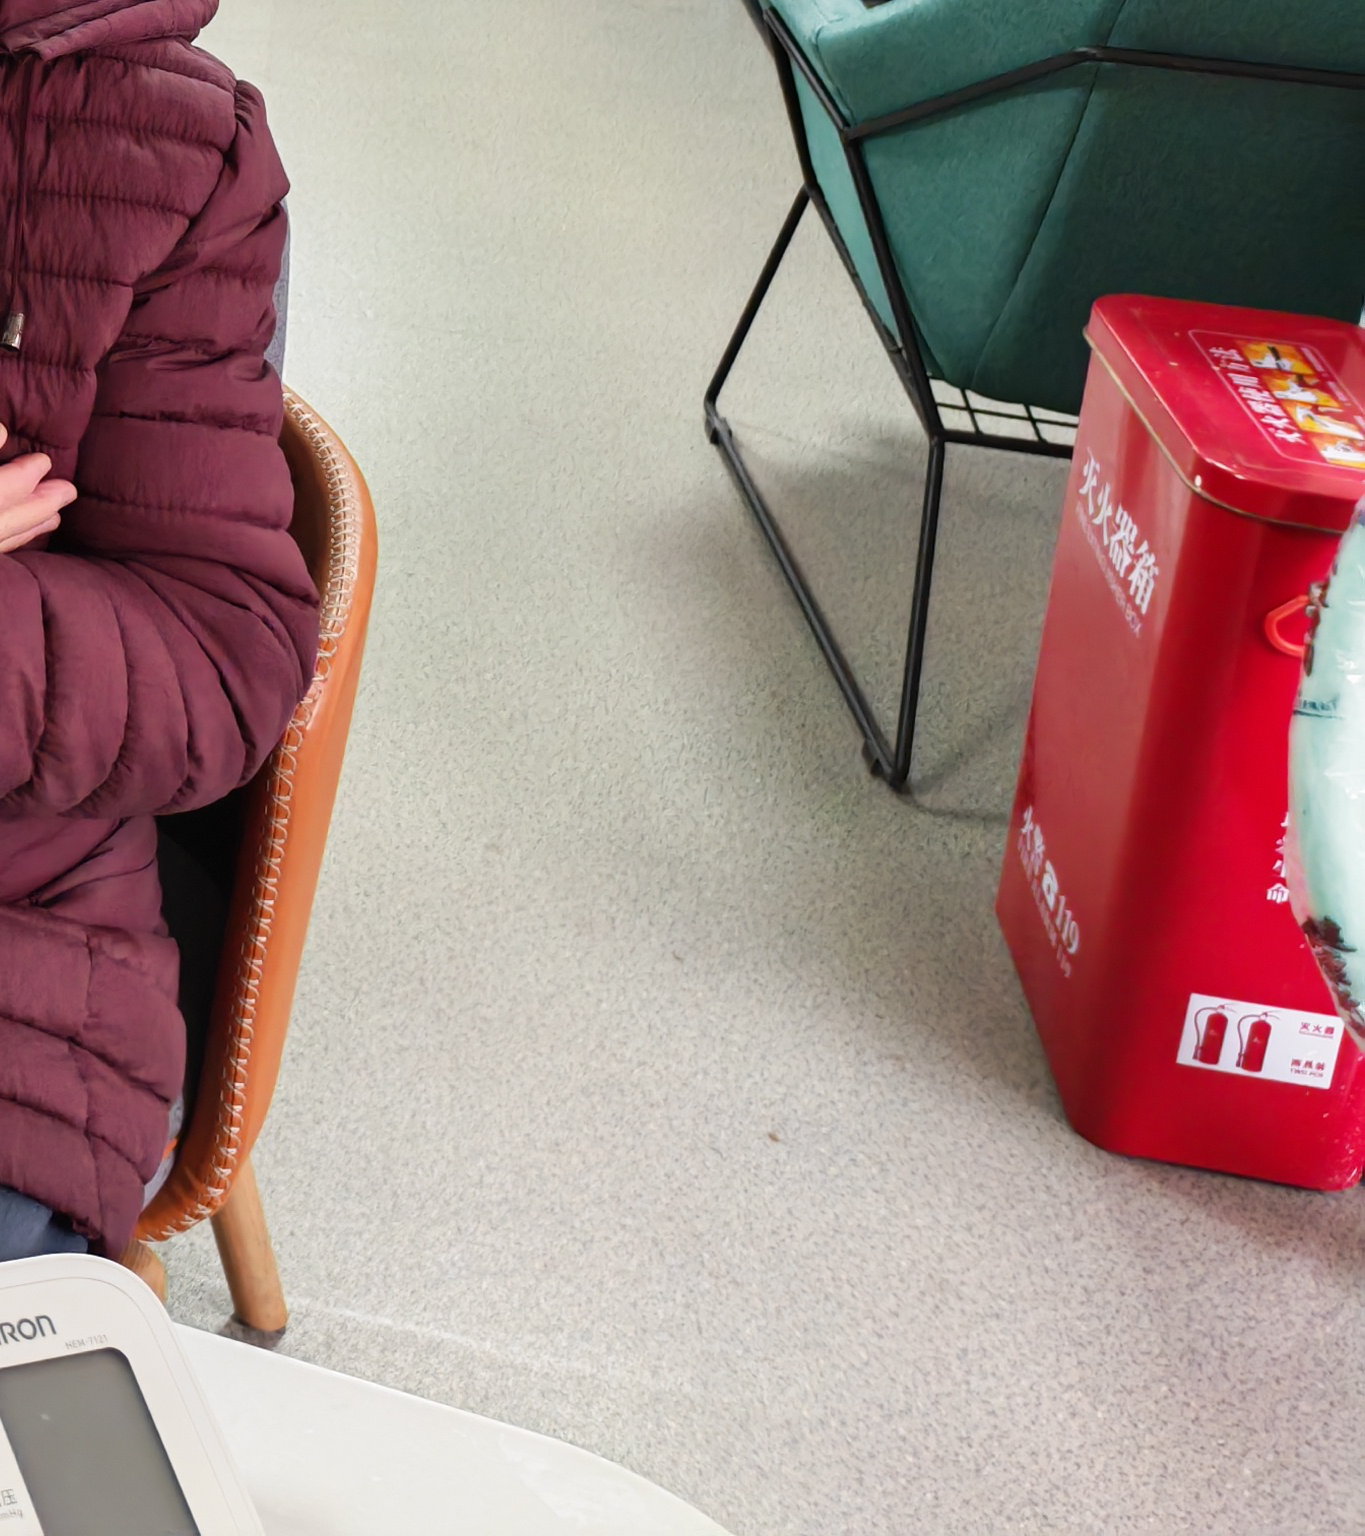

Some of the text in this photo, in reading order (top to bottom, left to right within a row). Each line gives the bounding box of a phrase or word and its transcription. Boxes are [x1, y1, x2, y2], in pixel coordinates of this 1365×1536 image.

[1079, 447, 1159, 615] 灭火器箱
[1055, 895, 1080, 954] 119
